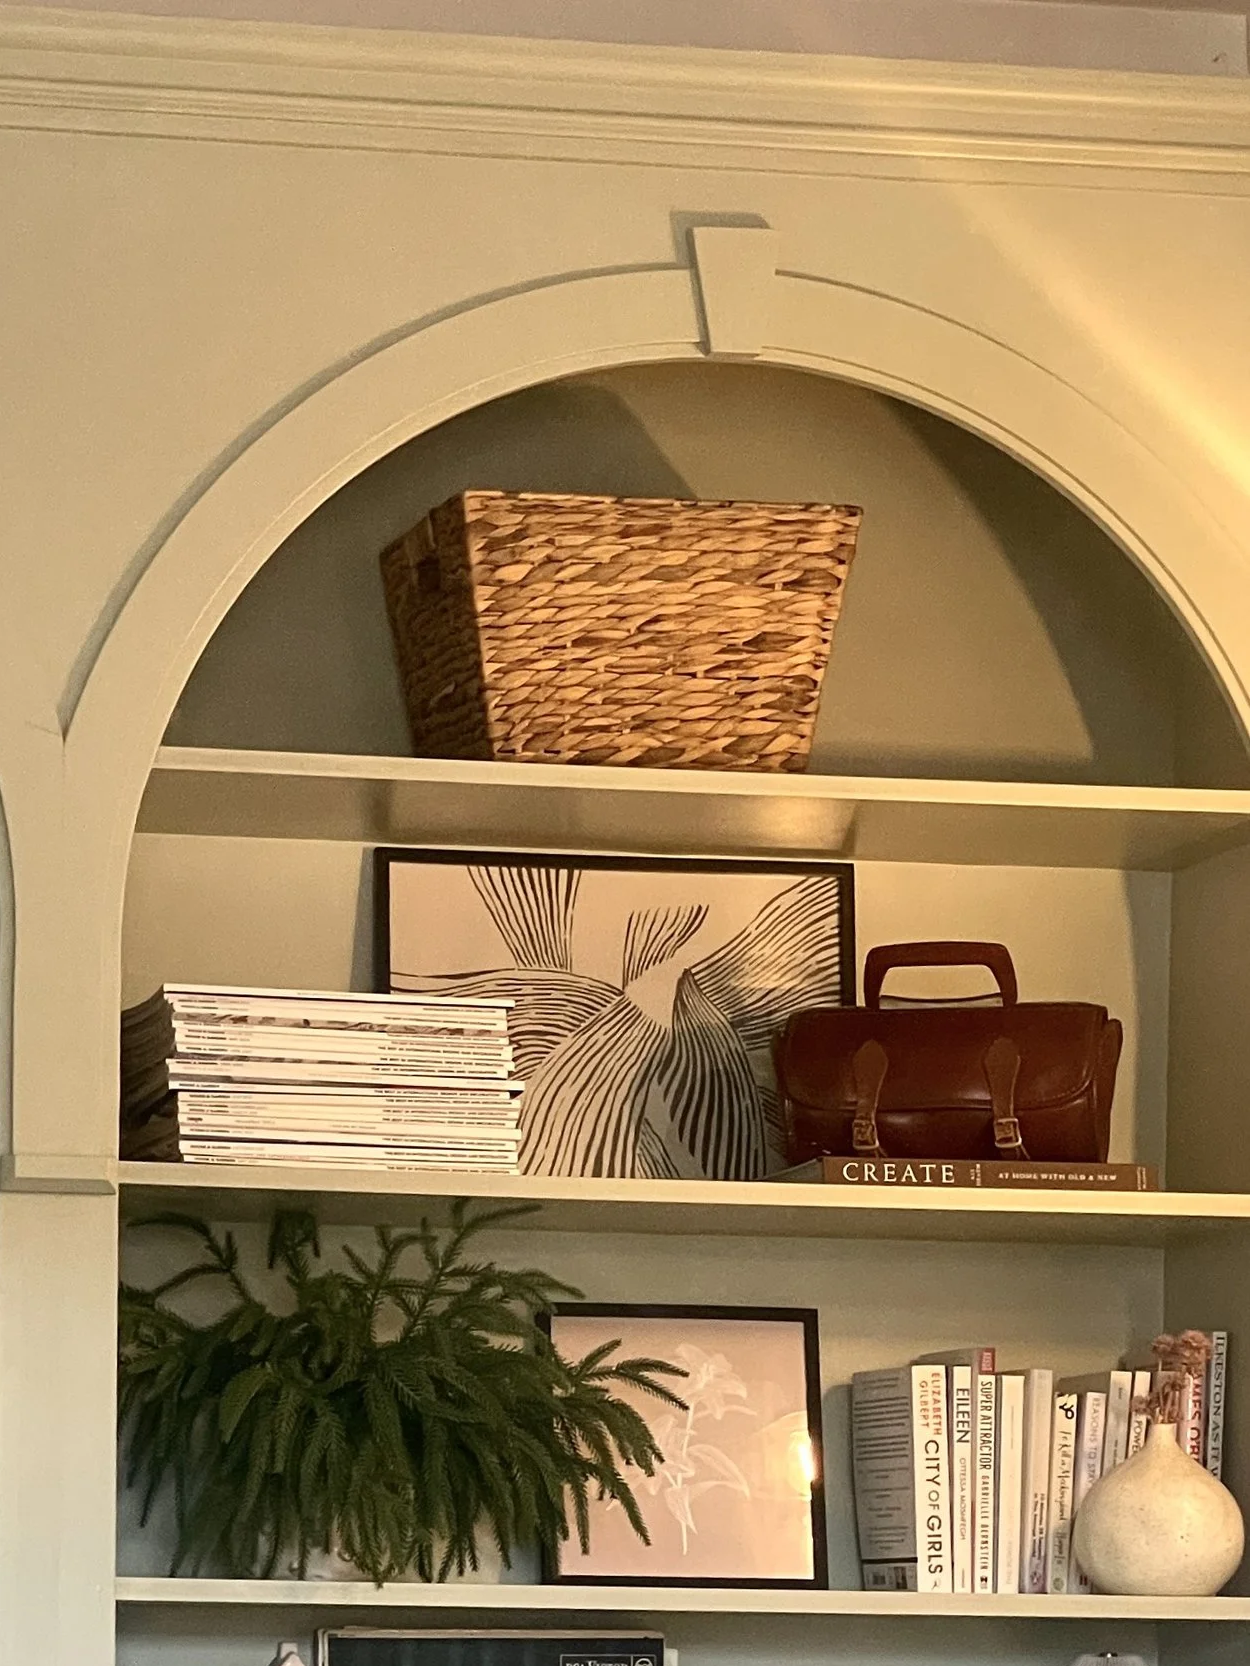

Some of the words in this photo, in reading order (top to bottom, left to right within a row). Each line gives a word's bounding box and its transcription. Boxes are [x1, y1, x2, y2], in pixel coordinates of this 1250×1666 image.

[841, 1161, 956, 1185] CREATE
[998, 1172, 1010, 1180] AT
[1012, 1172, 1039, 1181] HOME
[1040, 1173, 1066, 1181] WITH
[1068, 1174, 1086, 1182] OLD
[1097, 1174, 1118, 1182] NEW
[980, 1380, 993, 1412] SUPER
[1213, 1336, 1225, 1417] ILKESTON
[919, 1379, 930, 1429] GILBERT
[930, 1372, 943, 1437] ELIZABETH
[955, 1387, 971, 1444] EILEEN
[1090, 1398, 1100, 1445] REASONS
[979, 1413, 993, 1471] ATTRACTOR
[1057, 1443, 1072, 1458] Kill
[1087, 1448, 1096, 1463] TO
[1211, 1445, 1220, 1458] IT
[1212, 1425, 1222, 1441] AS
[924, 1439, 941, 1488] CITY
[1086, 1465, 1096, 1487] STAY
[927, 1490, 940, 1511] OF
[981, 1476, 990, 1520] GABRIELLE
[1054, 1466, 1071, 1521] Mockingbird
[926, 1515, 943, 1575] GIRLS
[980, 1524, 990, 1570] BERNSTEIN
